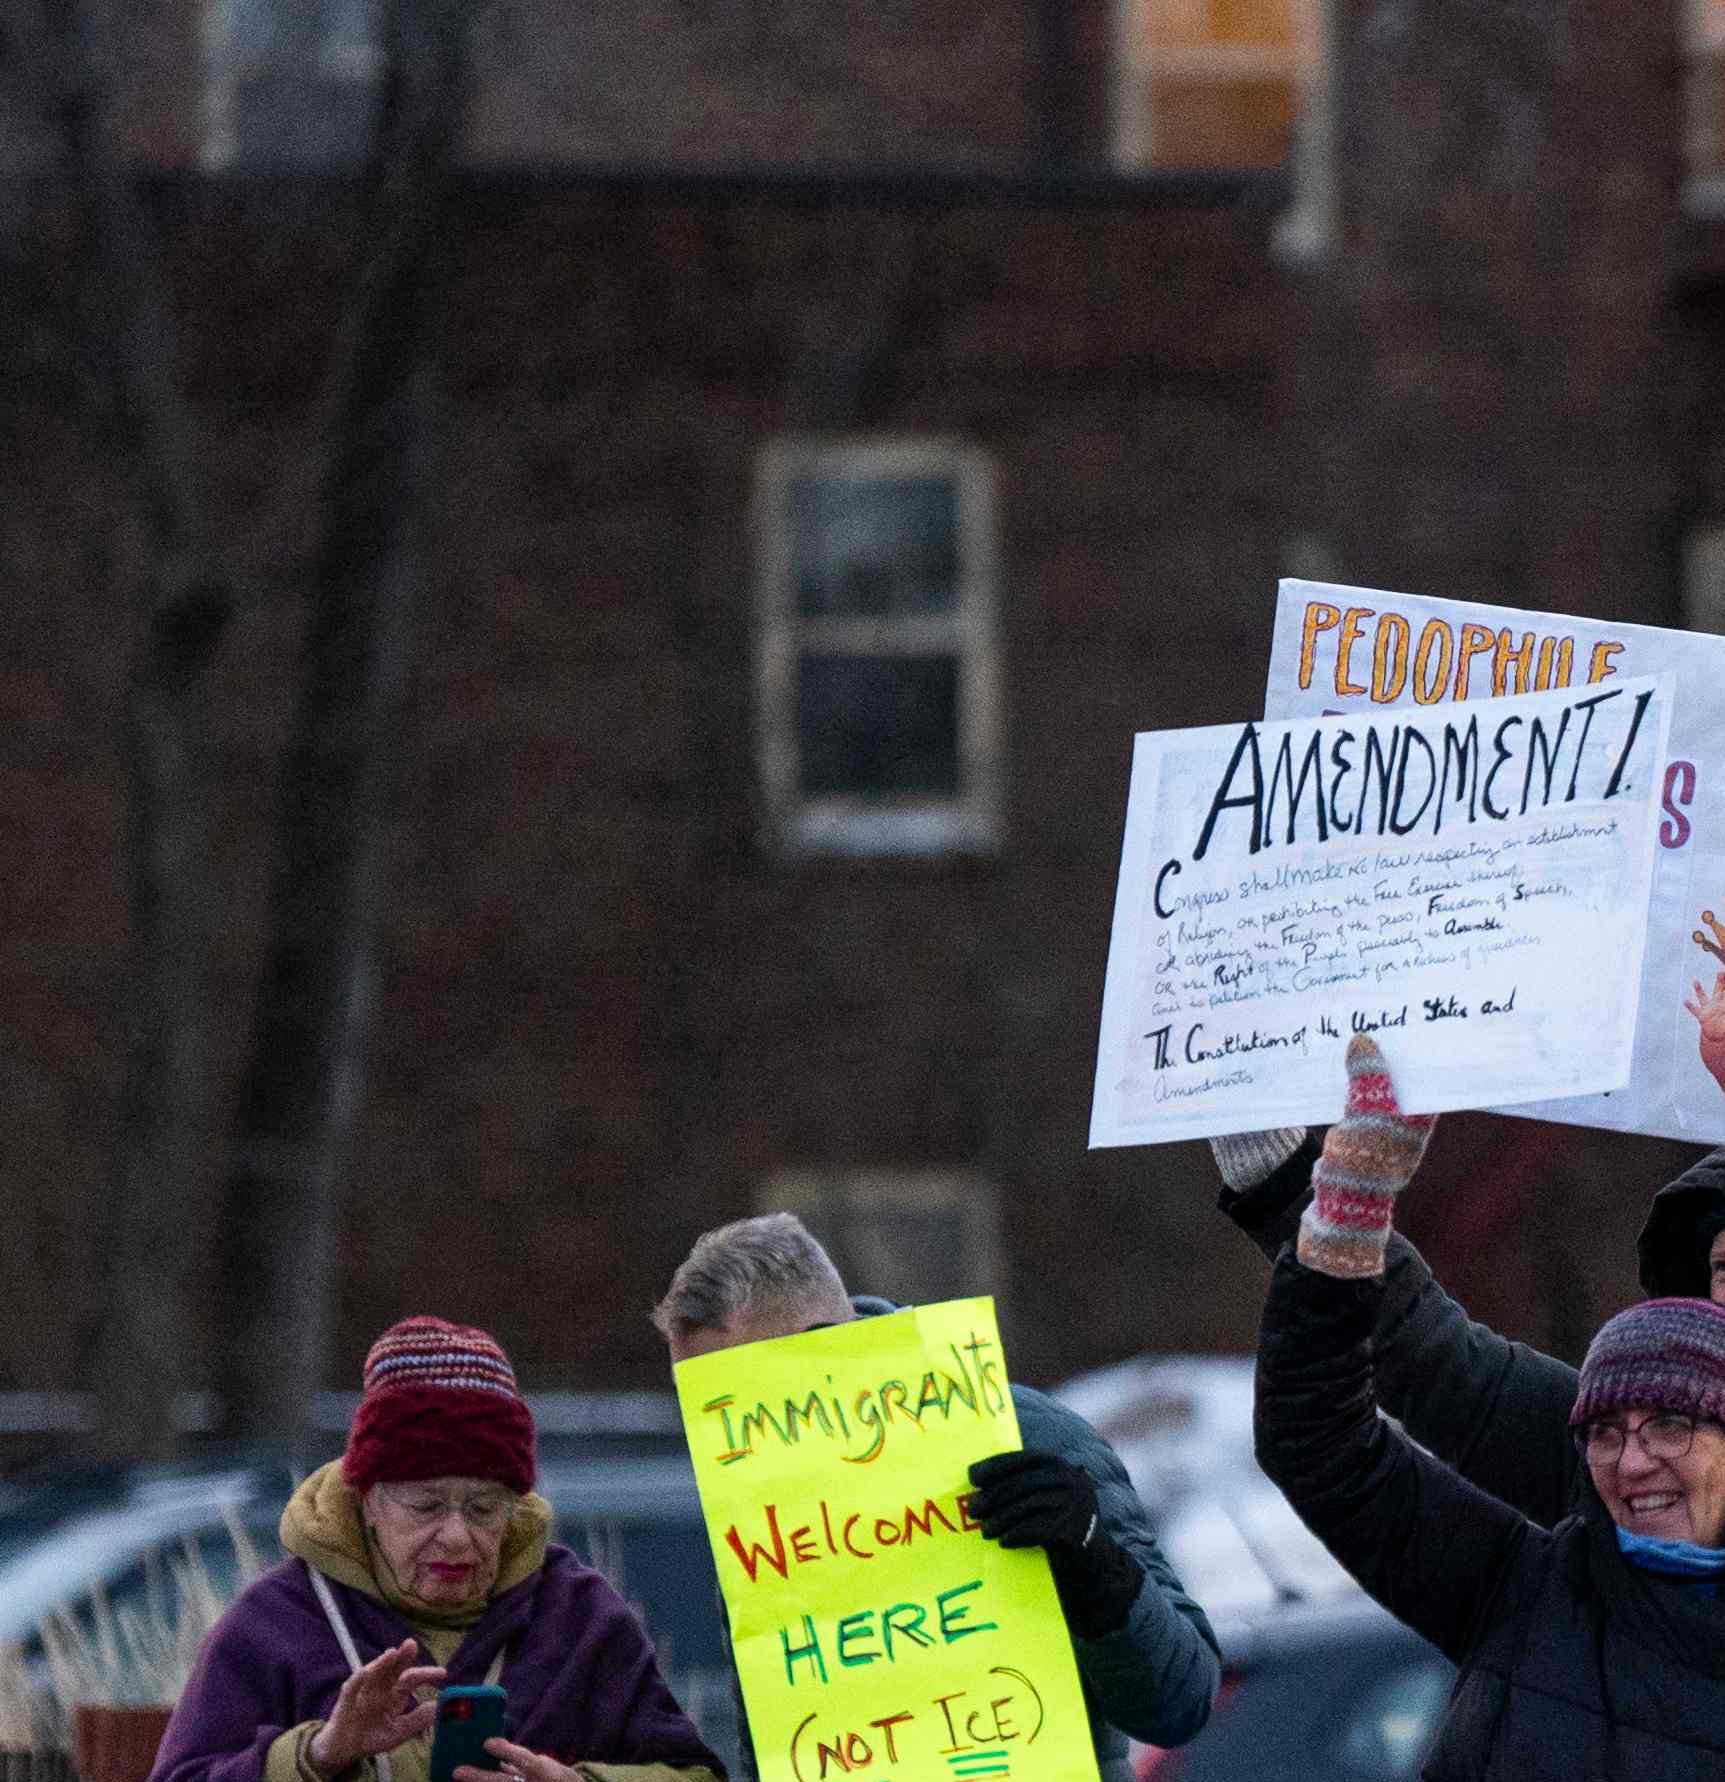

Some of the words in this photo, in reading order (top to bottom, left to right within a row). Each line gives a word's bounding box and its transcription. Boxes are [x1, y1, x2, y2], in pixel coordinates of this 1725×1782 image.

[1299, 601, 1626, 705] PEDOPHILE
[1193, 687, 1656, 861] AMENDMENT!
[778, 1579, 999, 1687] HERE
